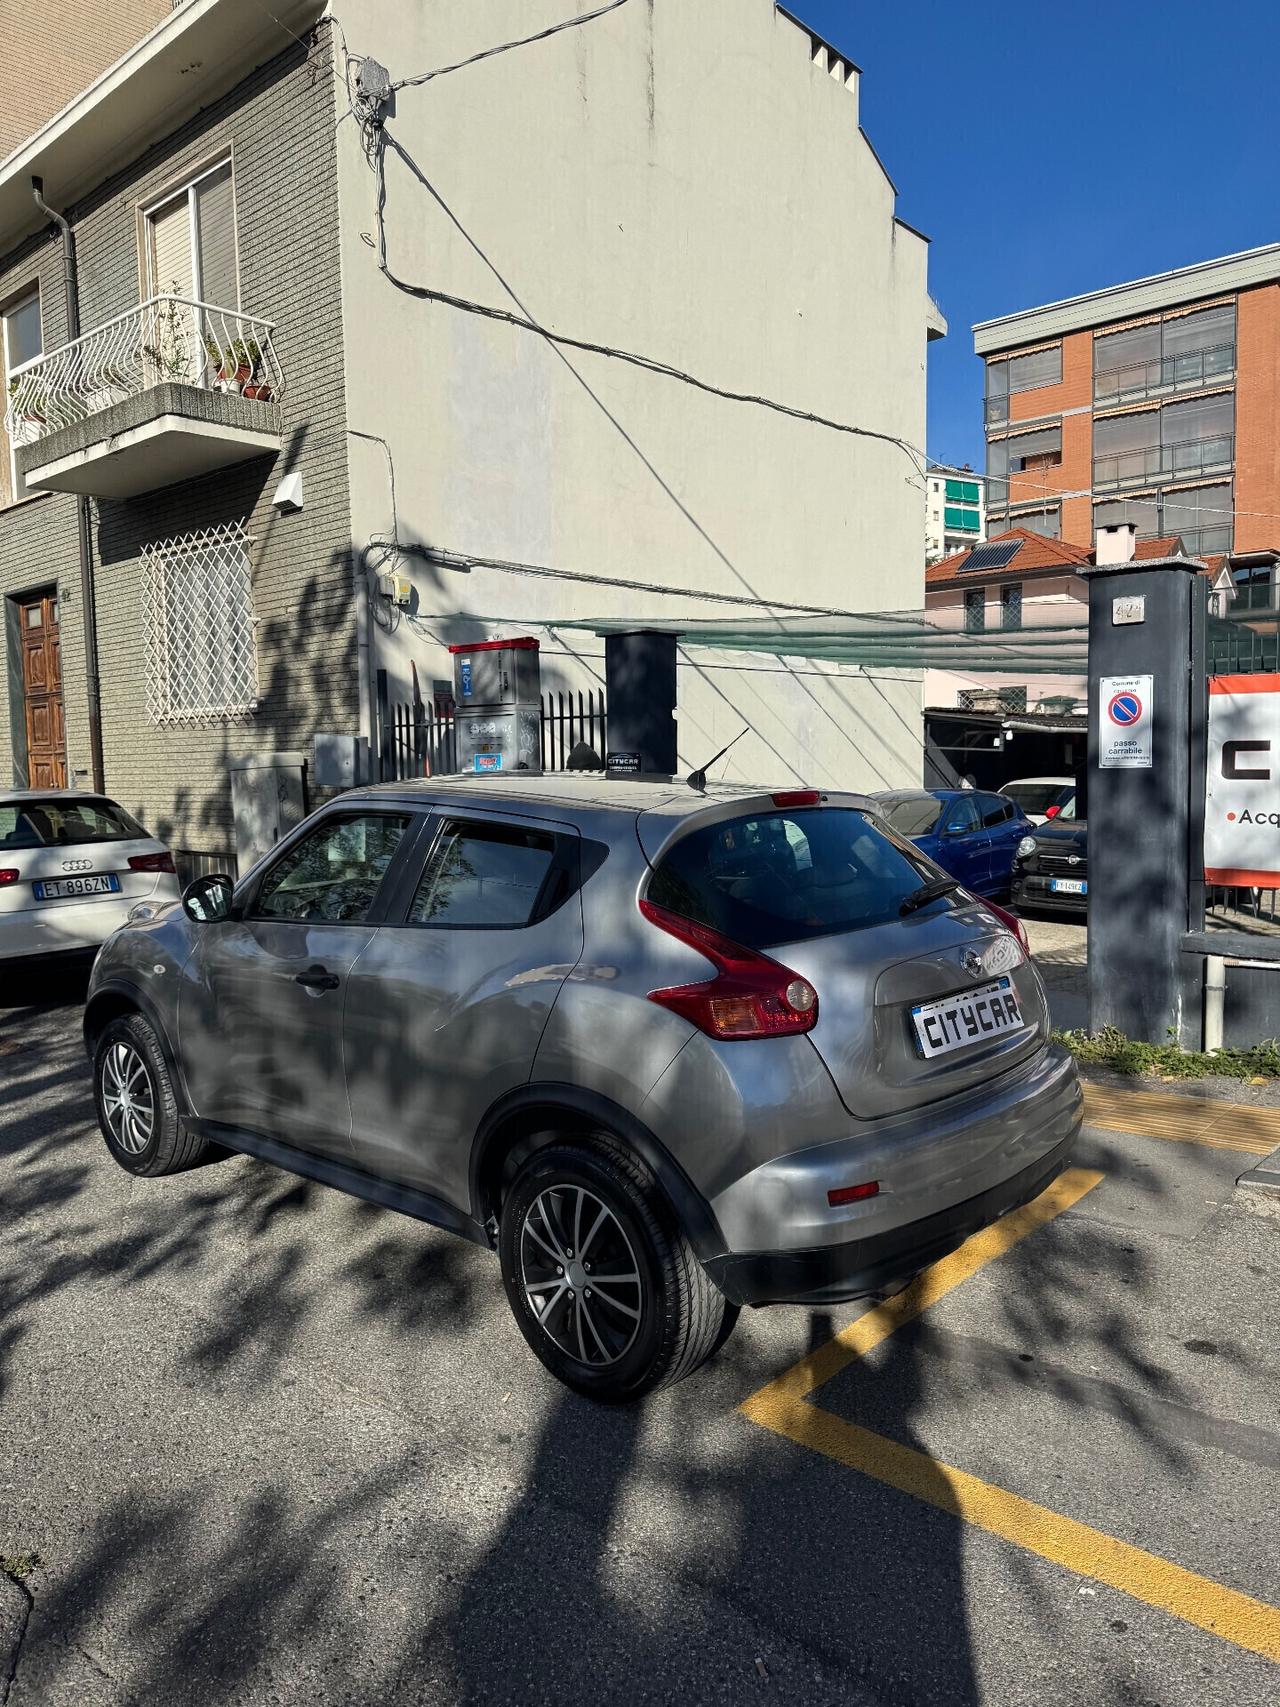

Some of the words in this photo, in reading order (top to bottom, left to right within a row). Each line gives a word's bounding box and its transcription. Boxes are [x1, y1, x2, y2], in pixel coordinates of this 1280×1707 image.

[1109, 747, 1142, 755] carrabile
[1221, 740, 1271, 780] C
[44, 881, 61, 898] ET
[66, 878, 110, 894] 896ZN
[923, 993, 1021, 1049] CITYCAR
